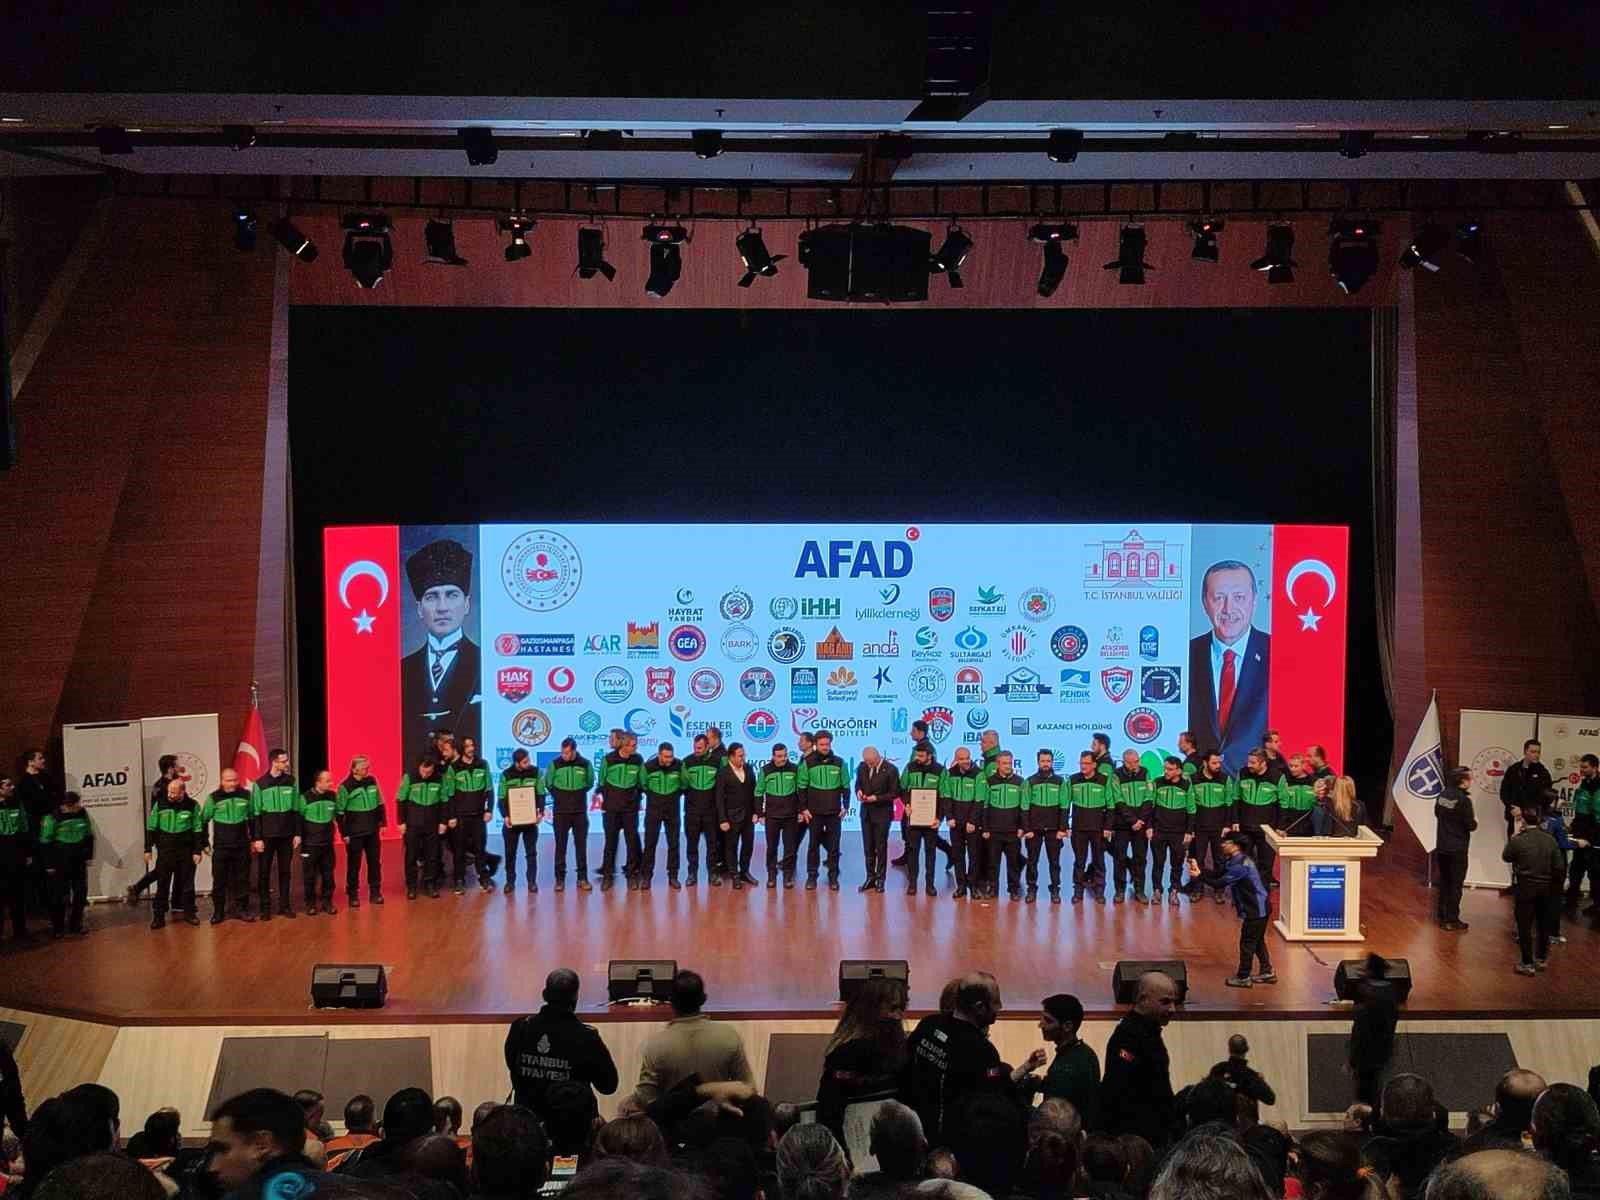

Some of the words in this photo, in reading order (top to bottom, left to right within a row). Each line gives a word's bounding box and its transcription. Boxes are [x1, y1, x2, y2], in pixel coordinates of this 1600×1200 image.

[794, 540, 914, 578] AFAD
[583, 634, 621, 652] ACAR
[500, 671, 529, 682] HAK
[956, 684, 980, 694] BAK
[540, 695, 584, 705] vodafone
[811, 717, 878, 729] GÜNGÖREN
[834, 729, 869, 737] EDİYESİ
[82, 772, 127, 788] AFAD
[519, 1053, 573, 1070] STANBUL
